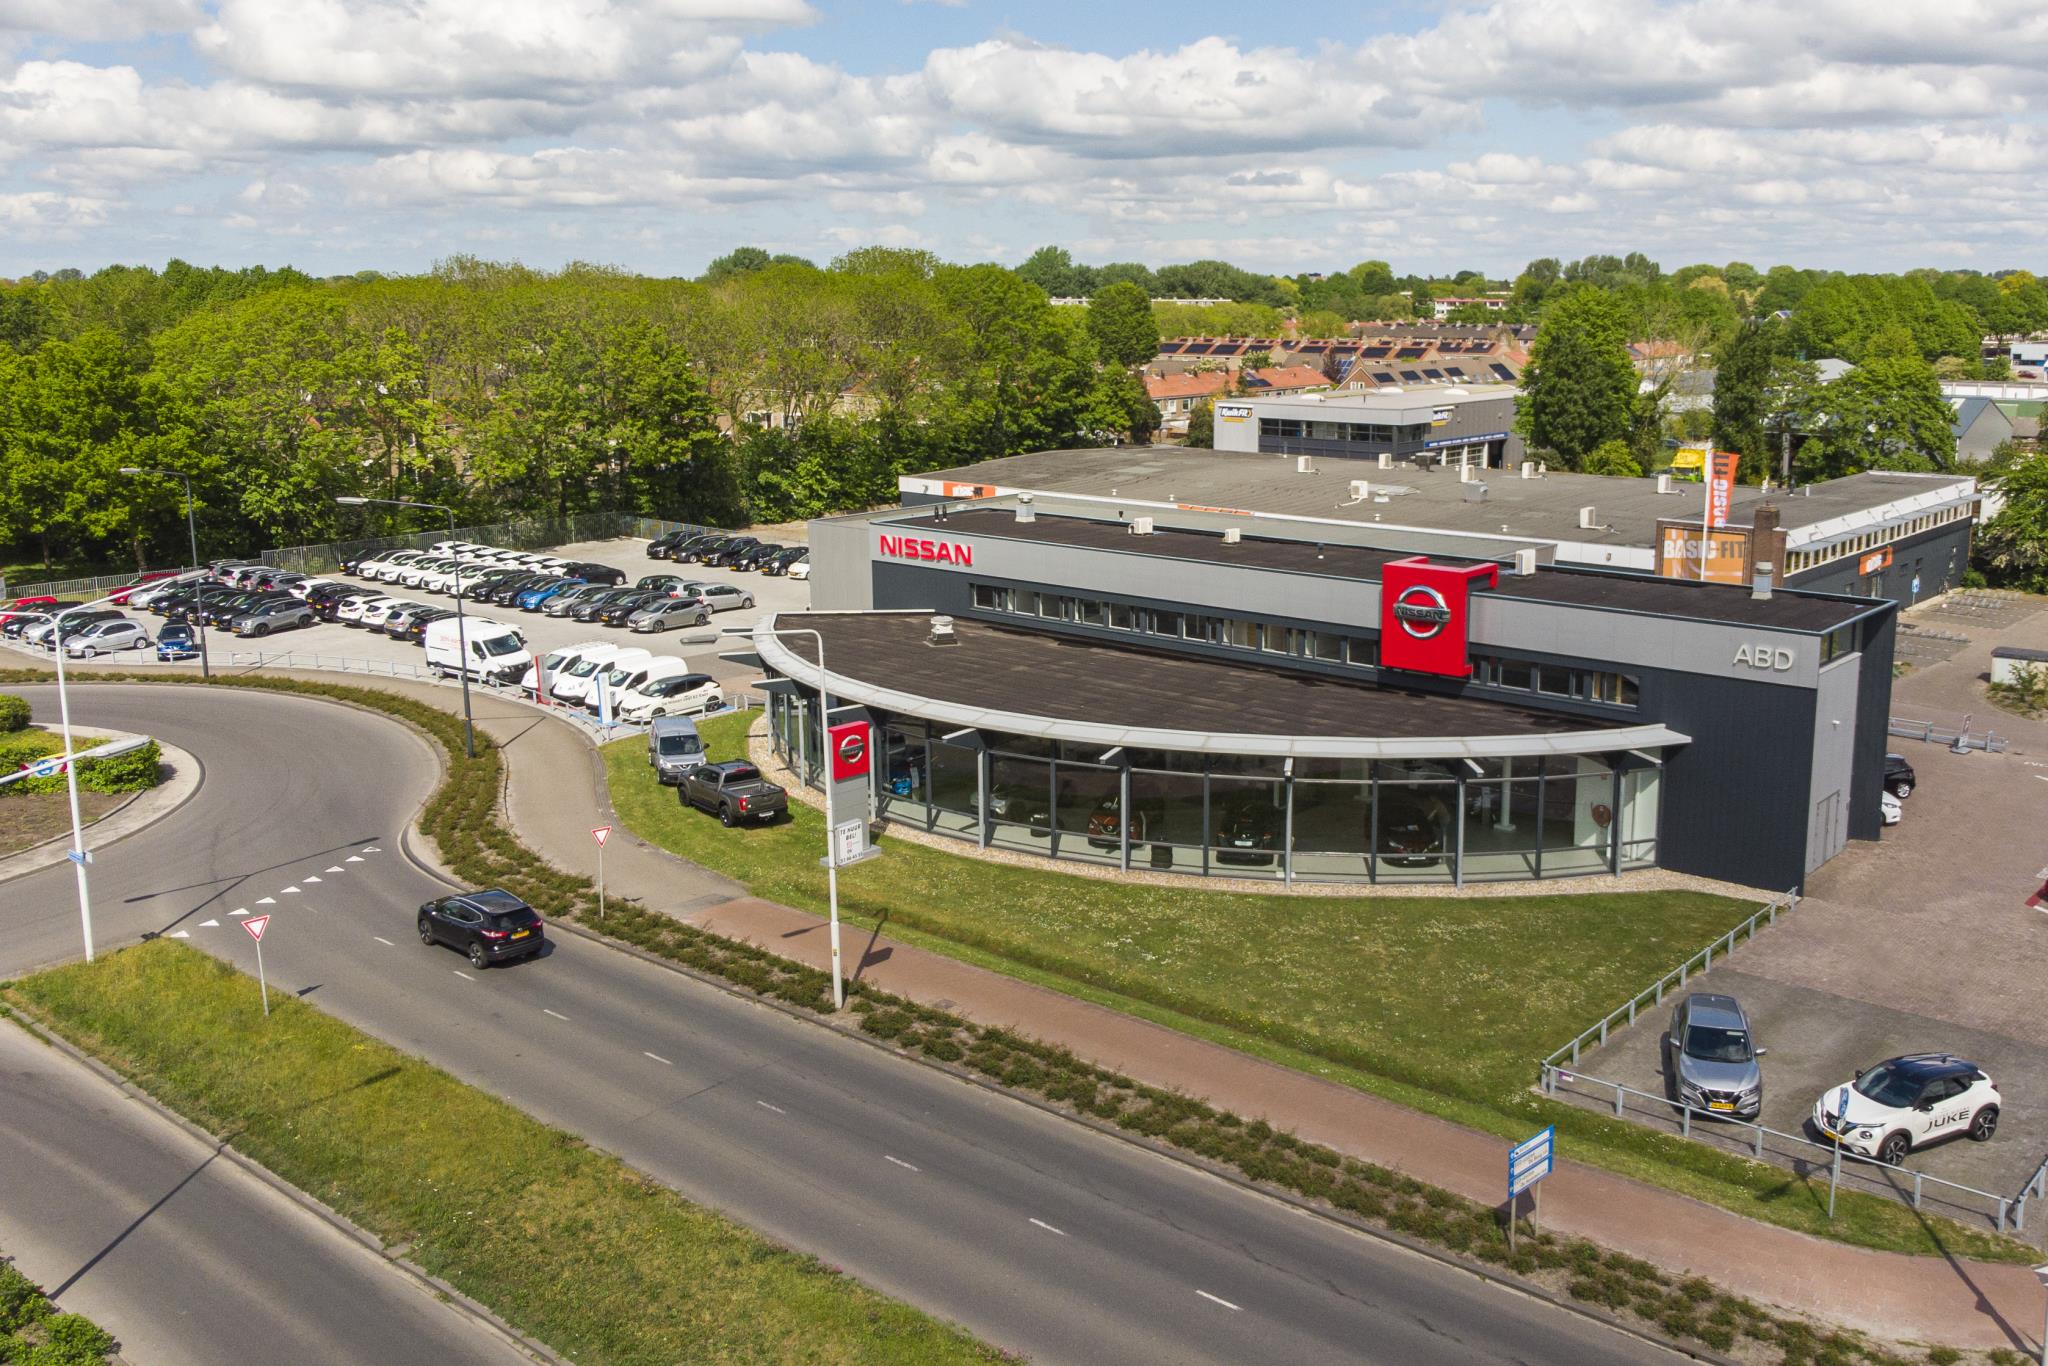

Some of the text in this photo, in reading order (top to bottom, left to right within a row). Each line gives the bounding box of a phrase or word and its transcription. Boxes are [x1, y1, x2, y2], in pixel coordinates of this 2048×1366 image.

[880, 535, 972, 566] NISSAN
[1397, 606, 1442, 620] NISSAN
[1733, 644, 1794, 670] ABD
[1923, 1110, 1970, 1134] JUKE
